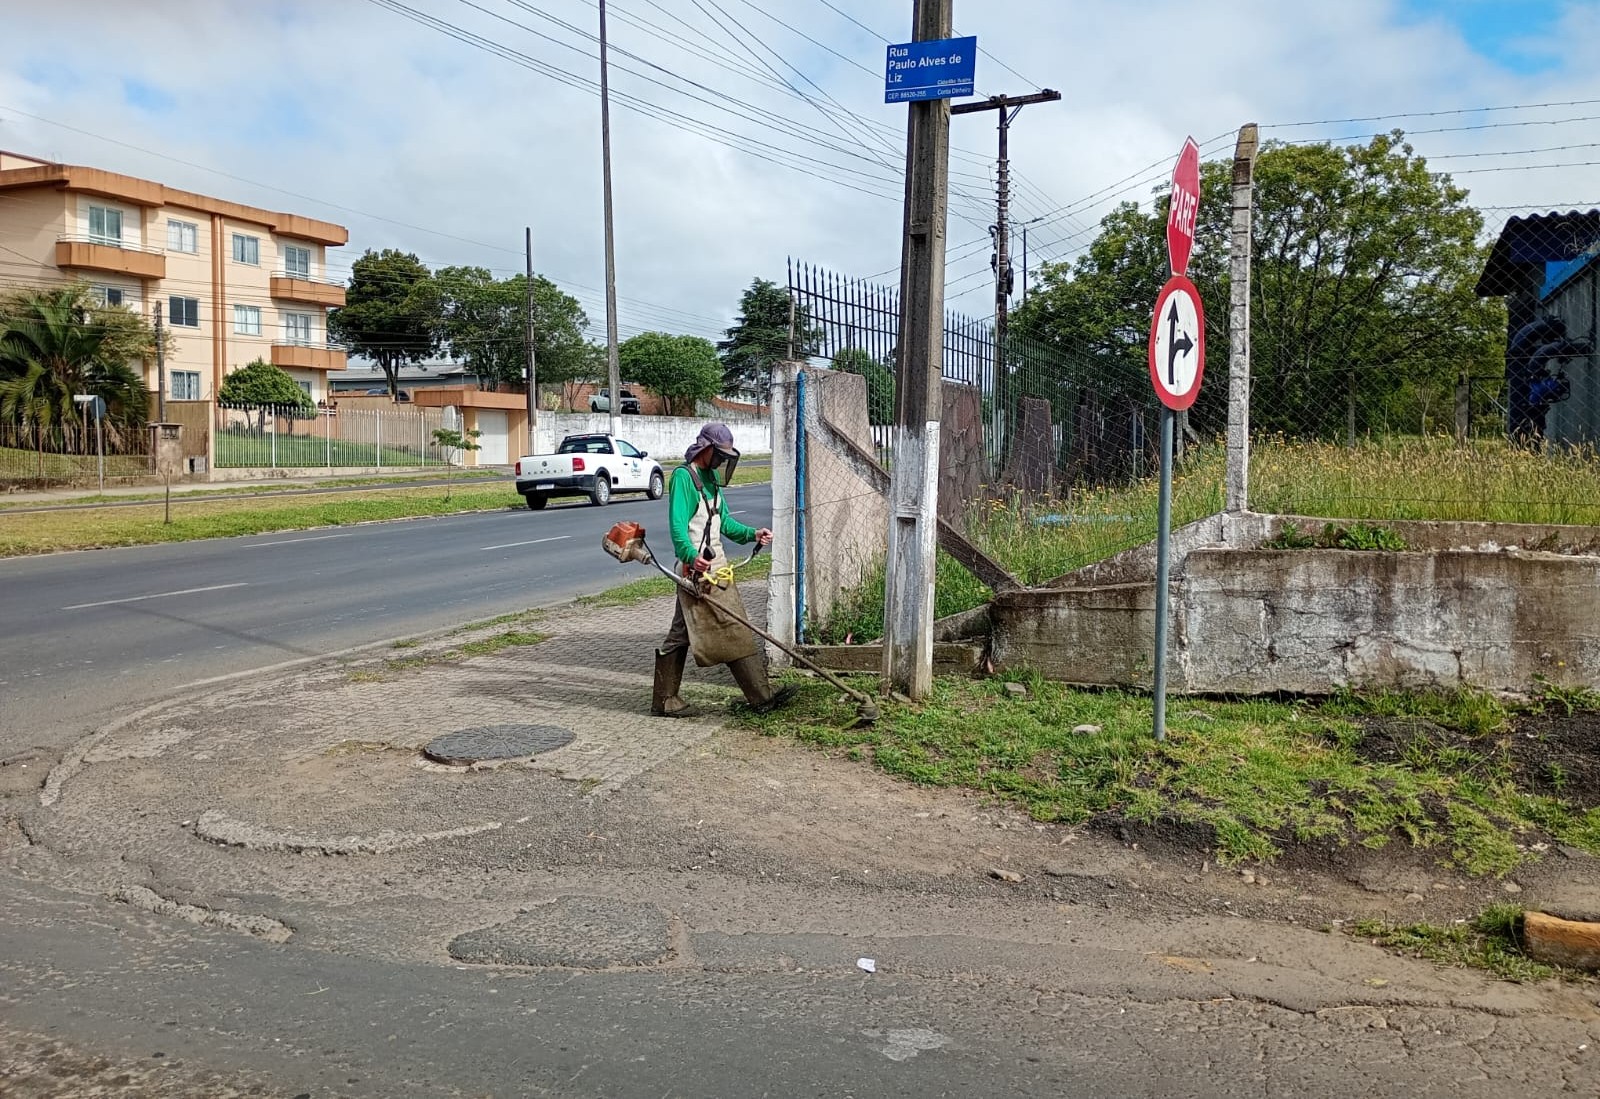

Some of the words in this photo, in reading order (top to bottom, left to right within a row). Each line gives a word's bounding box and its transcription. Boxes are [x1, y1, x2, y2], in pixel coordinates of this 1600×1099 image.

[889, 48, 908, 57] Rua
[888, 59, 916, 70] Paulo
[919, 57, 946, 68] Alves
[949, 54, 962, 64] de
[888, 73, 902, 83] Liz
[1169, 182, 1196, 238] PARE
